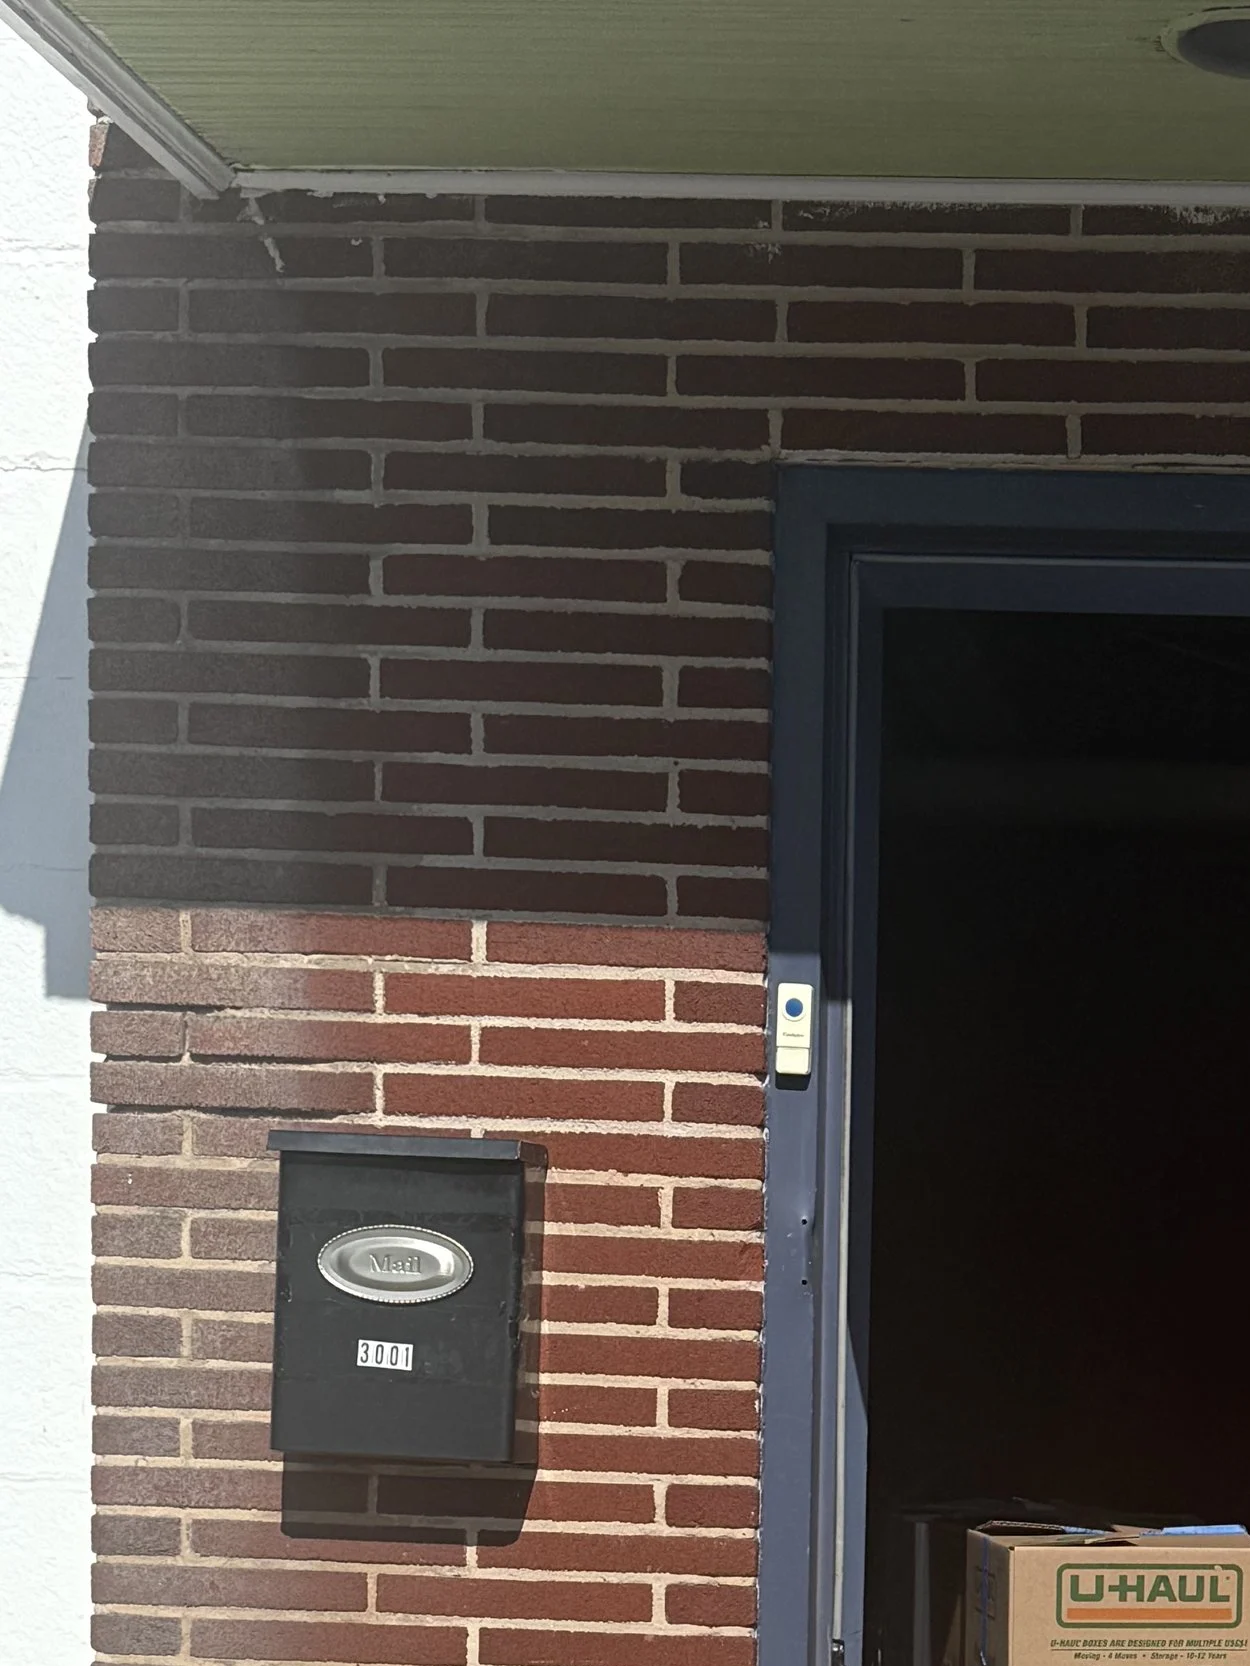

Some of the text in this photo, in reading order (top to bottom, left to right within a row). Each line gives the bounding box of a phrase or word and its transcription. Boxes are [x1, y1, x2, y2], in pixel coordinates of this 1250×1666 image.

[369, 1254, 421, 1275] Mail
[360, 1342, 410, 1368] 3001
[1070, 1575, 1230, 1603] U-HAUL
[1082, 1639, 1108, 1648] BOXES
[1109, 1639, 1126, 1648] ARE
[1127, 1639, 1166, 1648] DESIGNED
[1168, 1639, 1183, 1648] FOR
[1185, 1639, 1223, 1648] MULTIPLE
[1074, 1652, 1100, 1661] Moving
[1114, 1652, 1138, 1660] Moves
[1150, 1652, 1178, 1661] Storage
[1186, 1652, 1206, 1660] 10-12
[1208, 1652, 1227, 1660] Years
